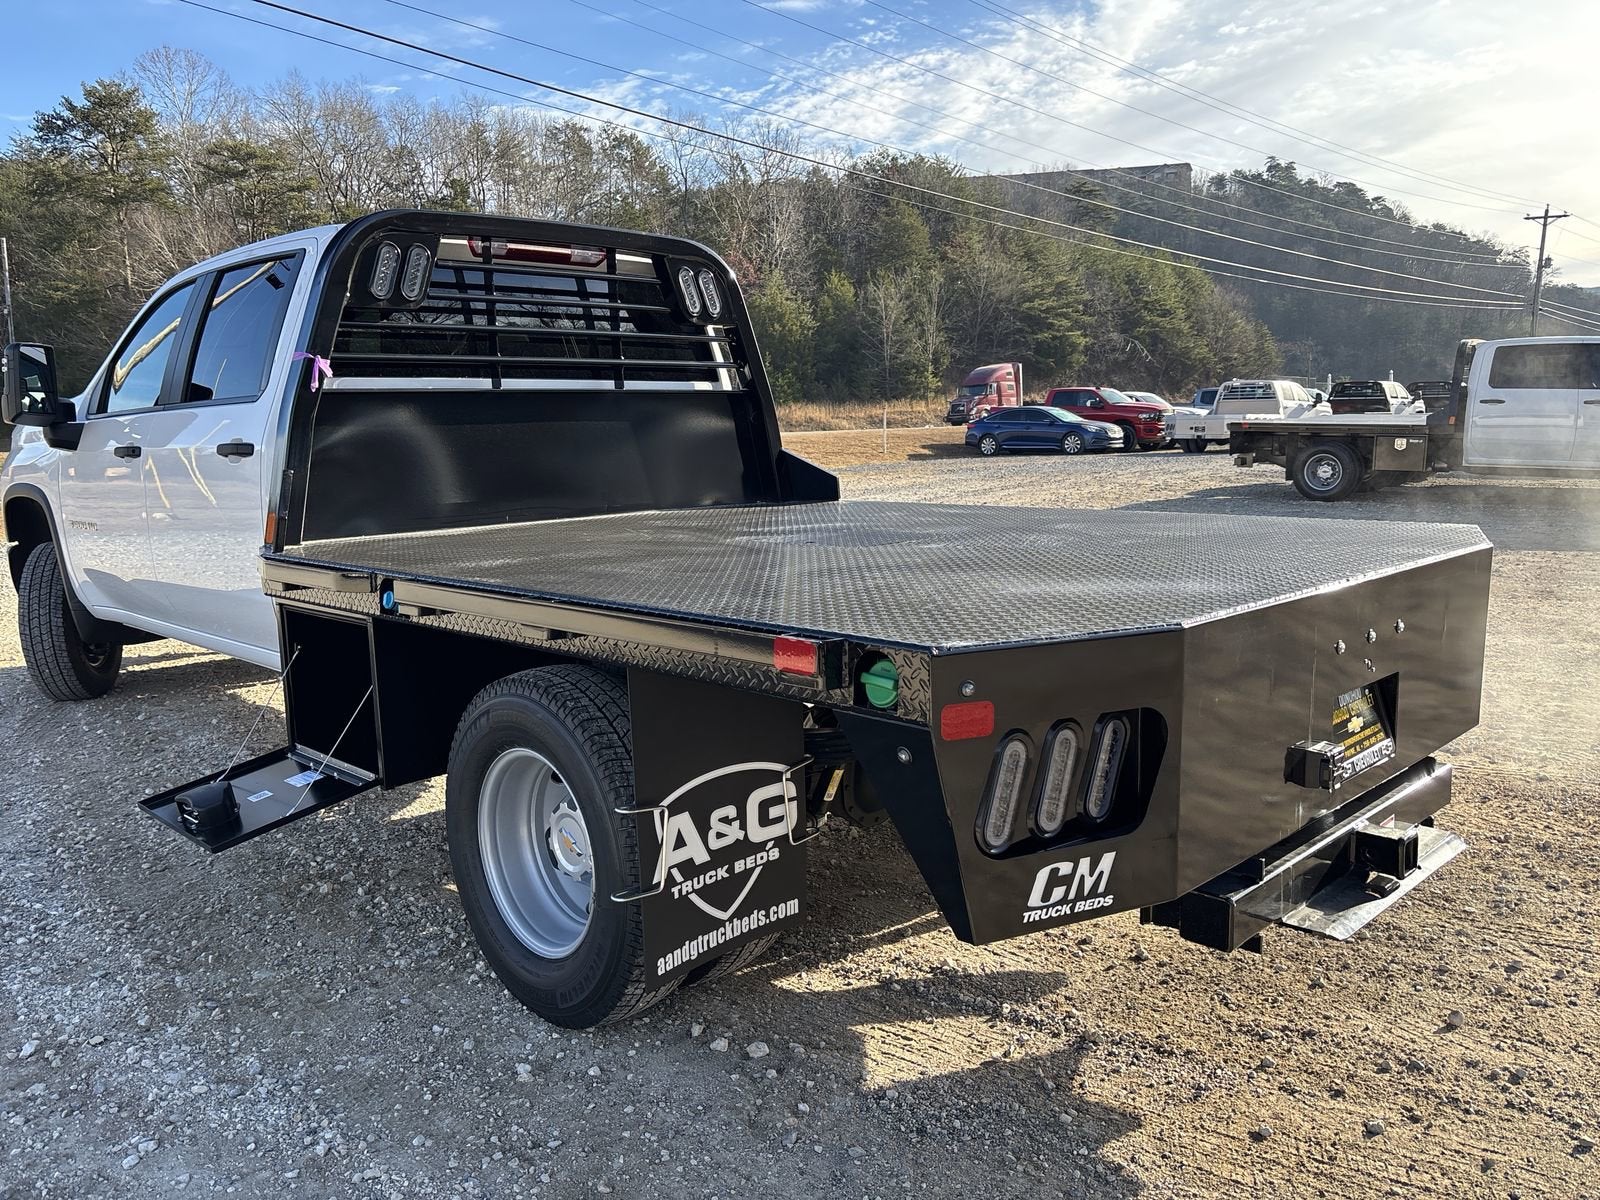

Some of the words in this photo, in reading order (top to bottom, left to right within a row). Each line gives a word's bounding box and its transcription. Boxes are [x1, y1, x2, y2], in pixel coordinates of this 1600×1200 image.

[1353, 748, 1381, 772] CHEVROLET
[652, 780, 798, 885] A&G
[671, 864, 730, 899] TRUCK
[734, 847, 780, 873] BEDS
[1027, 851, 1117, 907] CM
[1022, 903, 1073, 923] TRUCK
[1074, 895, 1115, 913] BEDS
[657, 898, 799, 976] aandgtruckbeds.com
